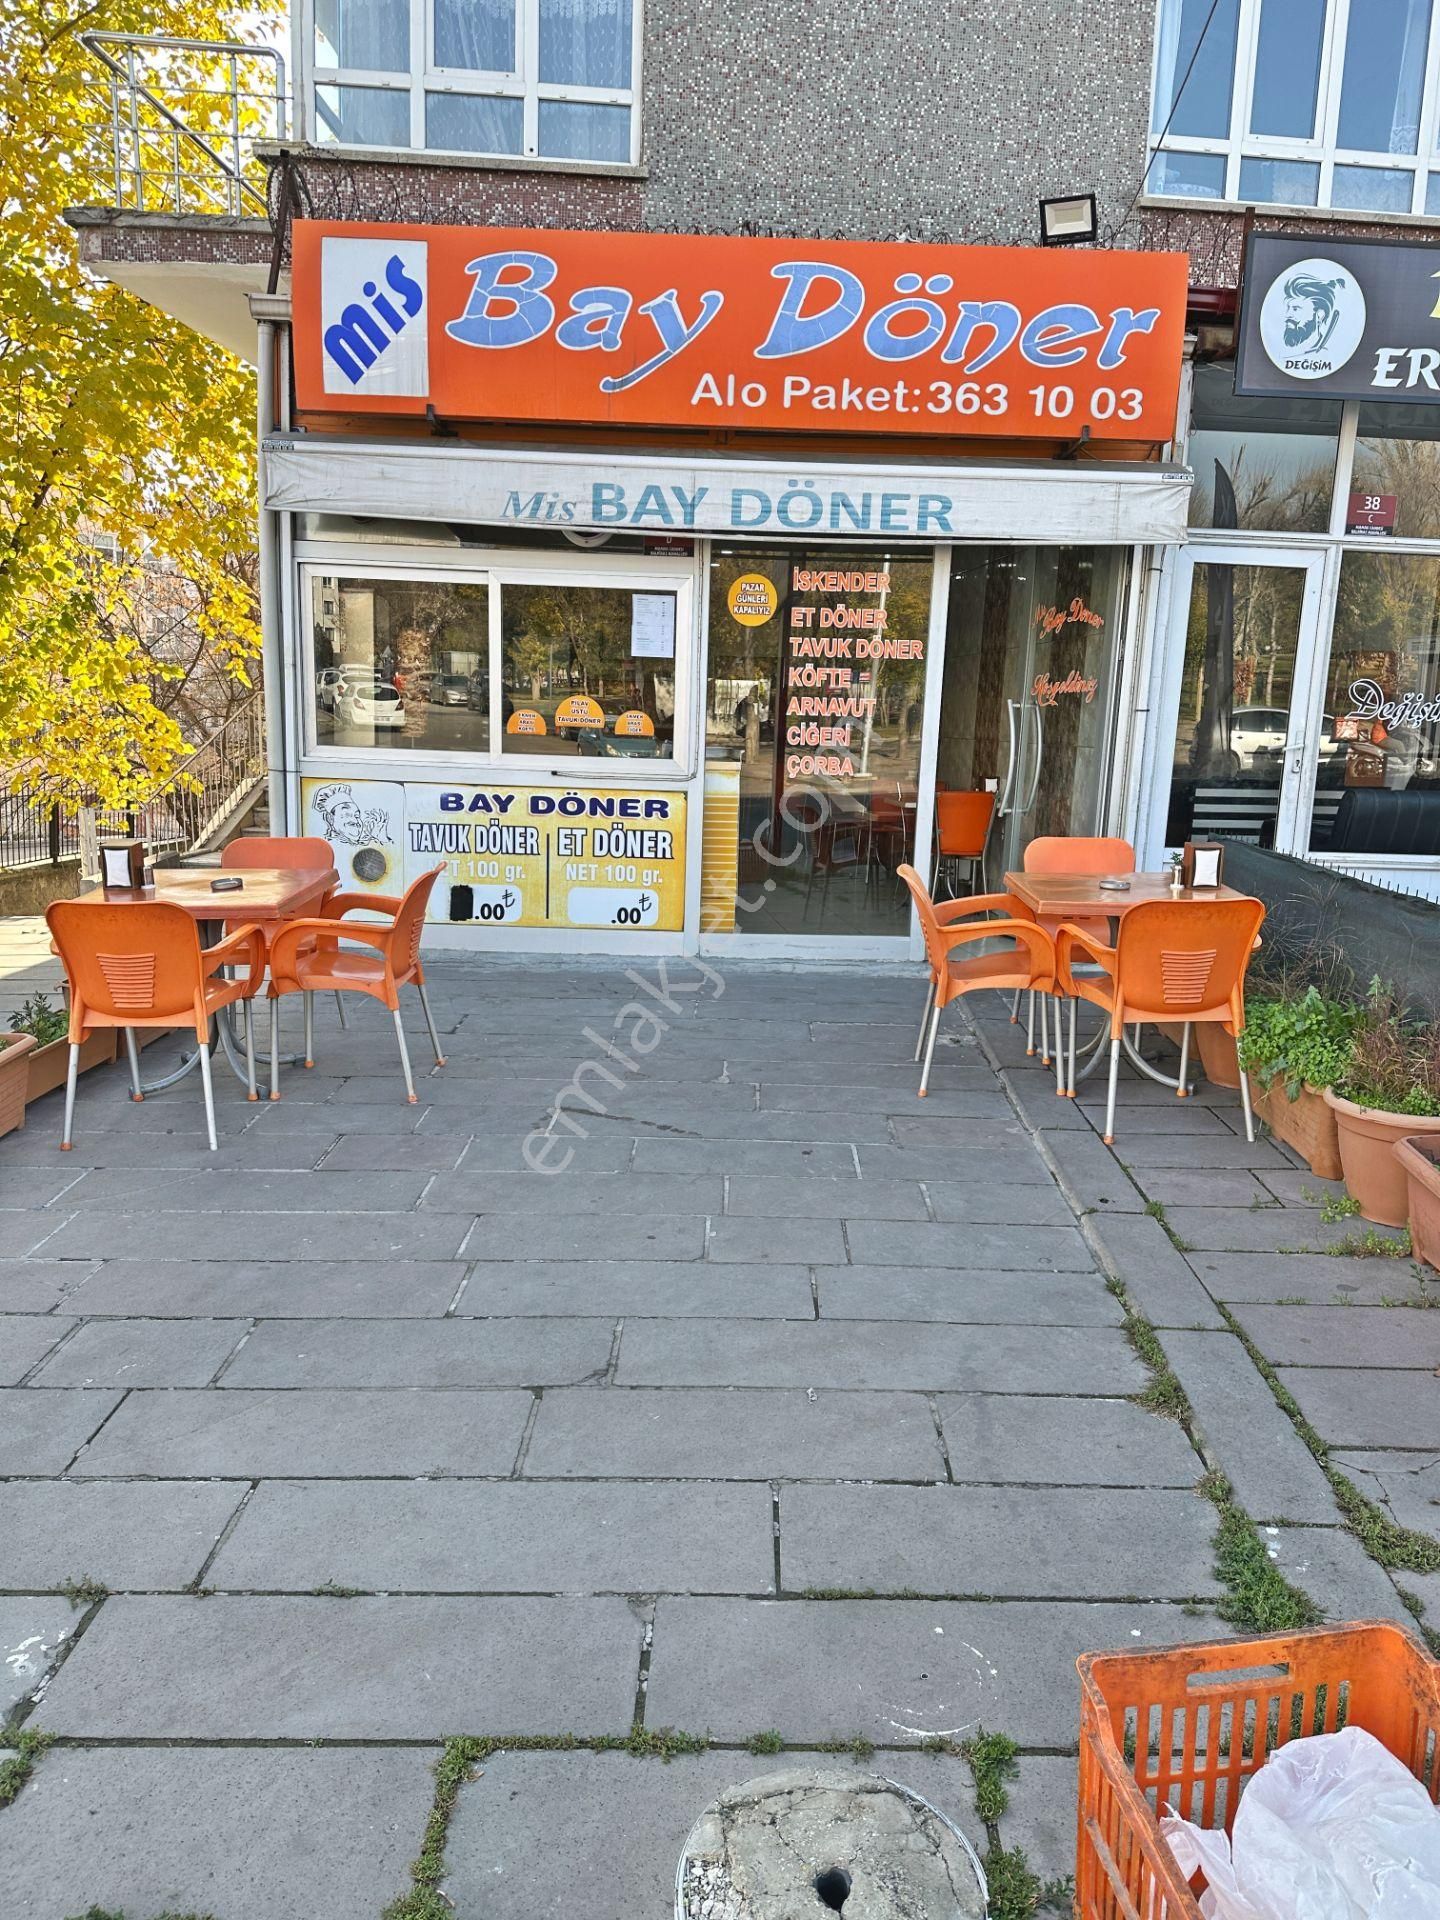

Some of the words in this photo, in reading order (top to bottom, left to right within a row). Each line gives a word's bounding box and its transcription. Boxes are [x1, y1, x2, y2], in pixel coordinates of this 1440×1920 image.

[445, 250, 724, 393] Bay
[753, 261, 1161, 374] Döner
[691, 372, 767, 408] Alo
[1029, 385, 1074, 417] 10
[1090, 388, 1143, 421] 03
[500, 490, 575, 521] Mis
[592, 483, 709, 527] BAY
[731, 479, 954, 532] DÖNER
[1364, 496, 1381, 510] 38
[1368, 514, 1374, 523] C
[741, 583, 765, 592] PAZAR
[792, 566, 891, 593] İSKENDER
[736, 592, 768, 603] GÜNLERİ
[733, 606, 771, 616] KAPALIYIZ
[790, 607, 815, 628] ET
[819, 604, 888, 629] DÖNER
[789, 637, 852, 658] TAVUK
[855, 635, 924, 660] DÖNER
[788, 663, 852, 688] KÖFTE
[786, 696, 877, 717] ARNAVUT
[786, 722, 851, 747] CİĞERİ
[786, 754, 854, 778] ÇORBA
[439, 791, 515, 814] BAY
[529, 791, 670, 819] DÖNER
[409, 822, 472, 855] TAVUK
[475, 818, 540, 856] DÖNER
[557, 827, 588, 857] ET
[594, 822, 675, 860] DÖNER
[467, 860, 499, 879] 100
[505, 865, 526, 882] gr.
[566, 863, 599, 881] NET
[605, 865, 637, 883] 100
[642, 869, 663, 887] gr.
